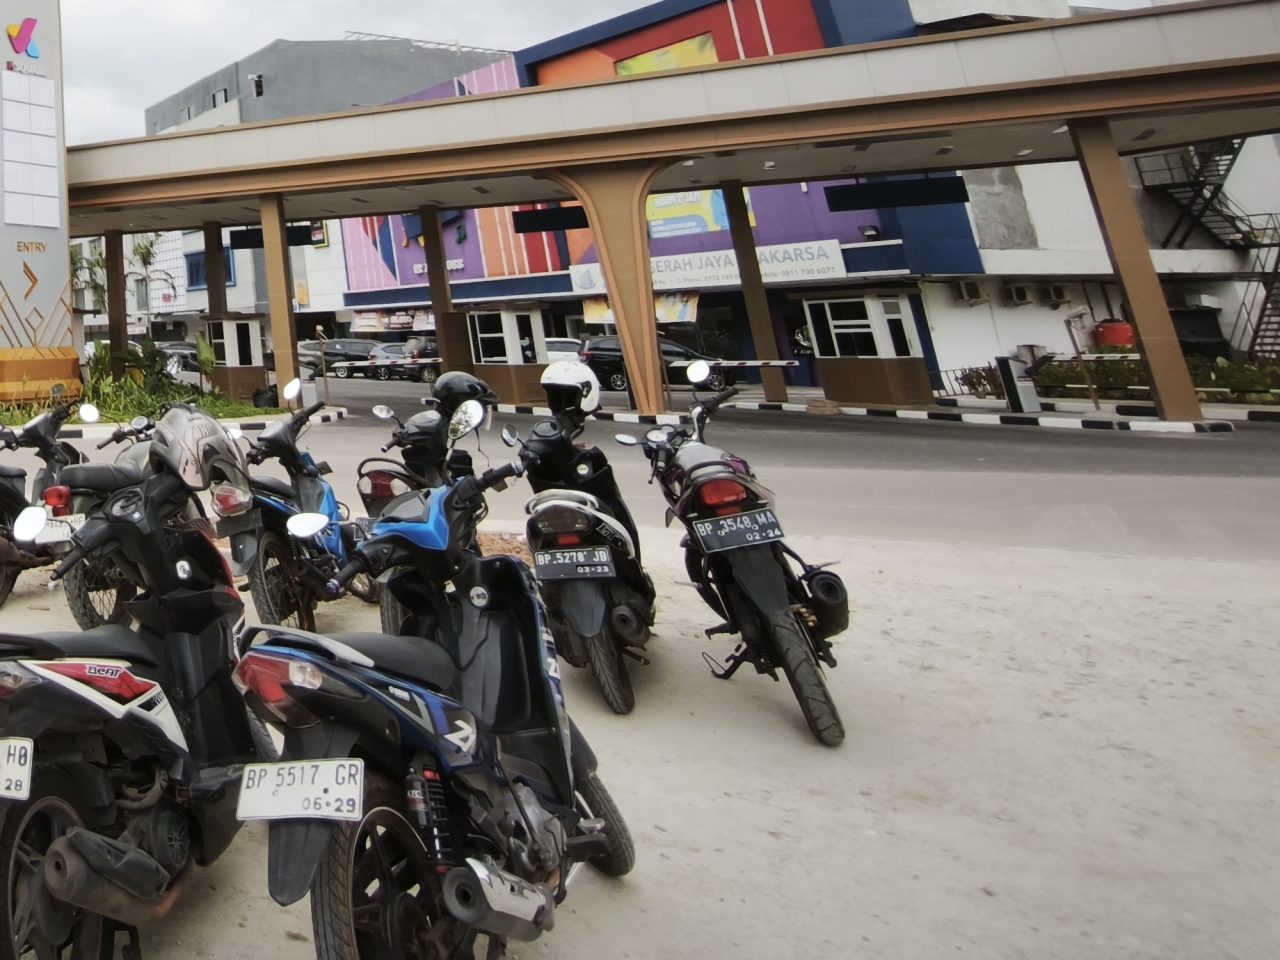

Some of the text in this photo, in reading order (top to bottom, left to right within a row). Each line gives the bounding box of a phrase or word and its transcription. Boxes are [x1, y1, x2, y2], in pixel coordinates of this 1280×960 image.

[16, 241, 47, 253] ENTRY
[697, 254, 735, 270] JAYA
[696, 510, 777, 537] BP 3548 MA
[537, 553, 551, 566] BP
[555, 551, 585, 564] 5278
[245, 763, 359, 789] BP 5517 GR
